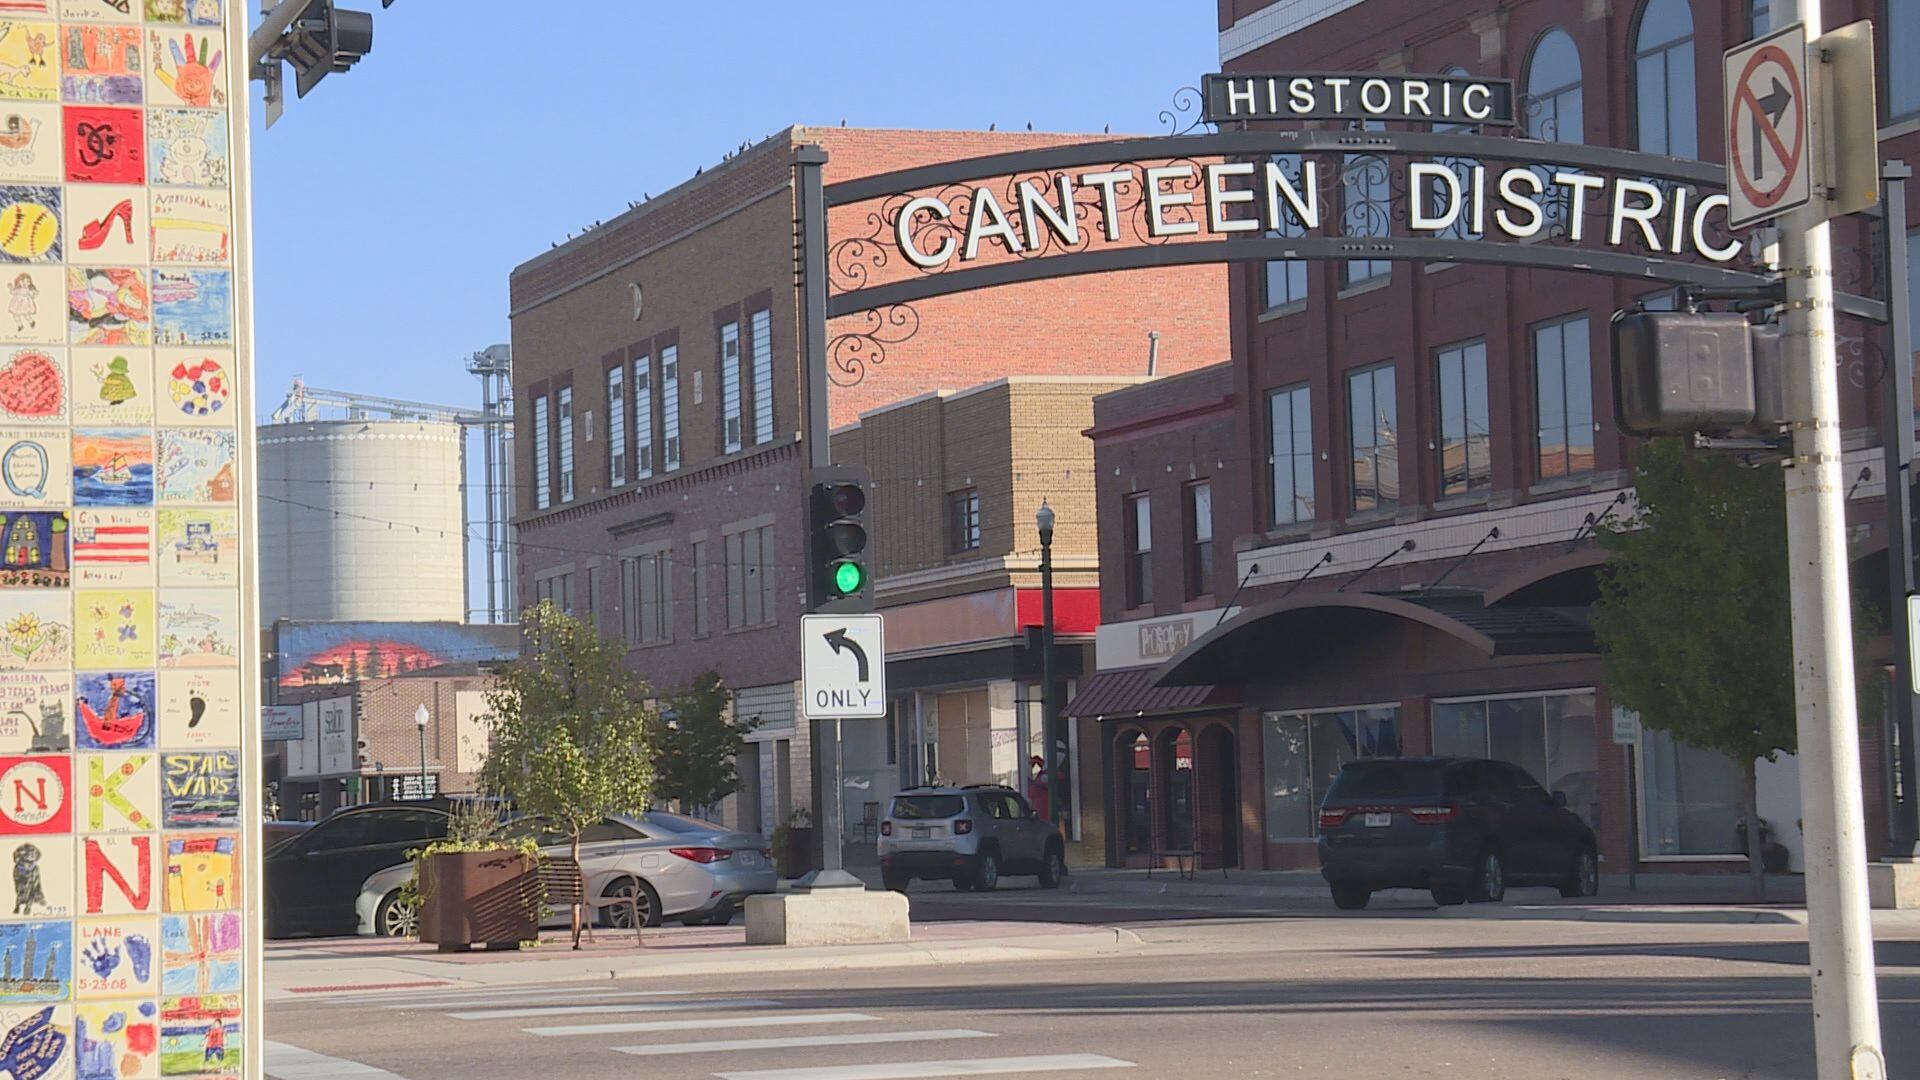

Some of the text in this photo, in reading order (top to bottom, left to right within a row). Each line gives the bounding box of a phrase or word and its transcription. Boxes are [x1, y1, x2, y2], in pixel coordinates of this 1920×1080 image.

[1227, 77, 1491, 120] HISTORIC
[894, 159, 1743, 268] CANTEEN DISTRIC
[816, 689, 871, 708] ONLY
[166, 754, 236, 776] STAR
[13, 778, 48, 813] N
[166, 777, 234, 797] WARS
[84, 836, 150, 913] N
[82, 927, 121, 938] LANE
